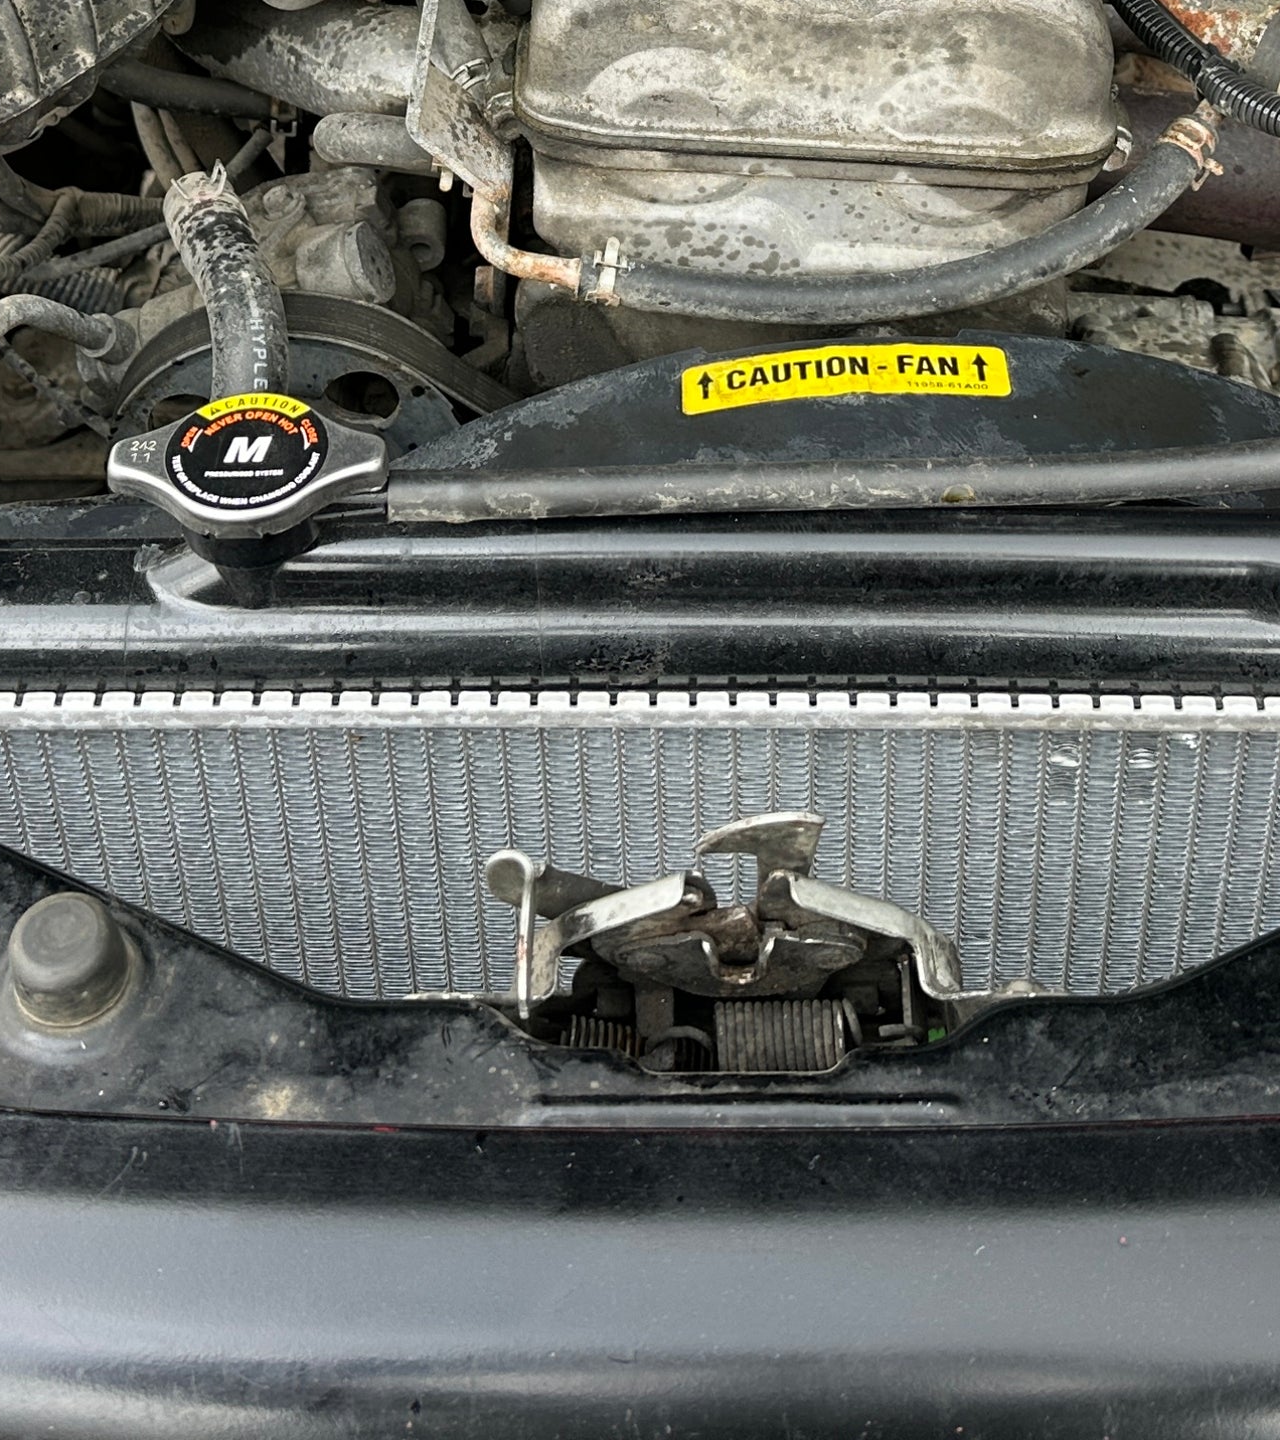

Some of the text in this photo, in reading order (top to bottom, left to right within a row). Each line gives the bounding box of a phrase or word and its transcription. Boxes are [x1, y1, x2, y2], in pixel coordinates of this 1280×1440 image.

[727, 356, 869, 391] CAUTION
[897, 354, 960, 377] FAN
[225, 397, 300, 413] CAUTION
[204, 411, 299, 436] NEVER OPEN HOT
[301, 419, 318, 443] CLOSE
[223, 436, 273, 464] M
[183, 480, 219, 503] REPLACE
[219, 496, 248, 505] WHEN
